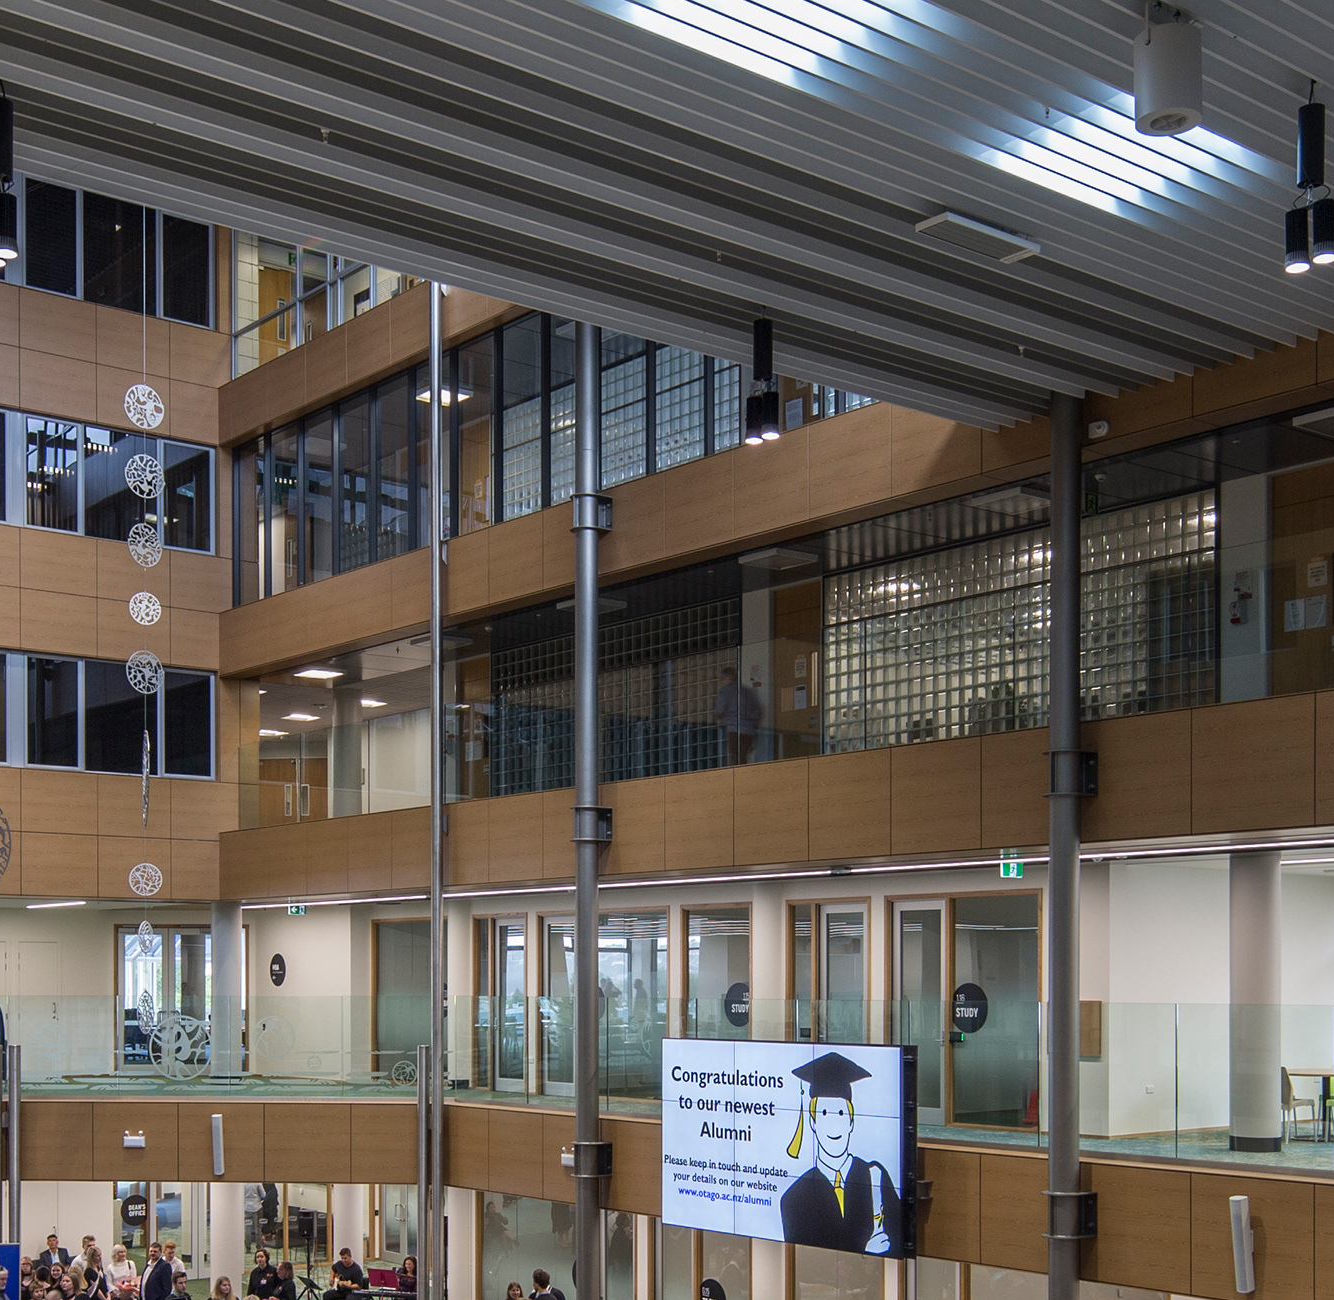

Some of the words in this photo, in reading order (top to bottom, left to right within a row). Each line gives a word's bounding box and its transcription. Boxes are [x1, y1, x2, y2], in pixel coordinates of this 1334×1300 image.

[731, 1004, 749, 1013] STUDY
[955, 1008, 979, 1018] STUDY
[671, 1066, 784, 1088] Congratulations
[679, 1094, 693, 1110] to
[697, 1098, 721, 1112] our
[725, 1100, 775, 1116] newest
[700, 1122, 751, 1142] Alumni
[664, 1154, 687, 1166] Please
[689, 1157, 707, 1170] keep
[709, 1160, 717, 1170] in
[718, 1161, 741, 1172] touch
[743, 1164, 757, 1174] and
[759, 1166, 788, 1178] update
[673, 1172, 690, 1182] your
[692, 1173, 717, 1184] details
[719, 1178, 729, 1186] on
[731, 1178, 744, 1188] our
[747, 1180, 777, 1192] website
[678, 1187, 772, 1206] www.otago.ac.nz/alumni
